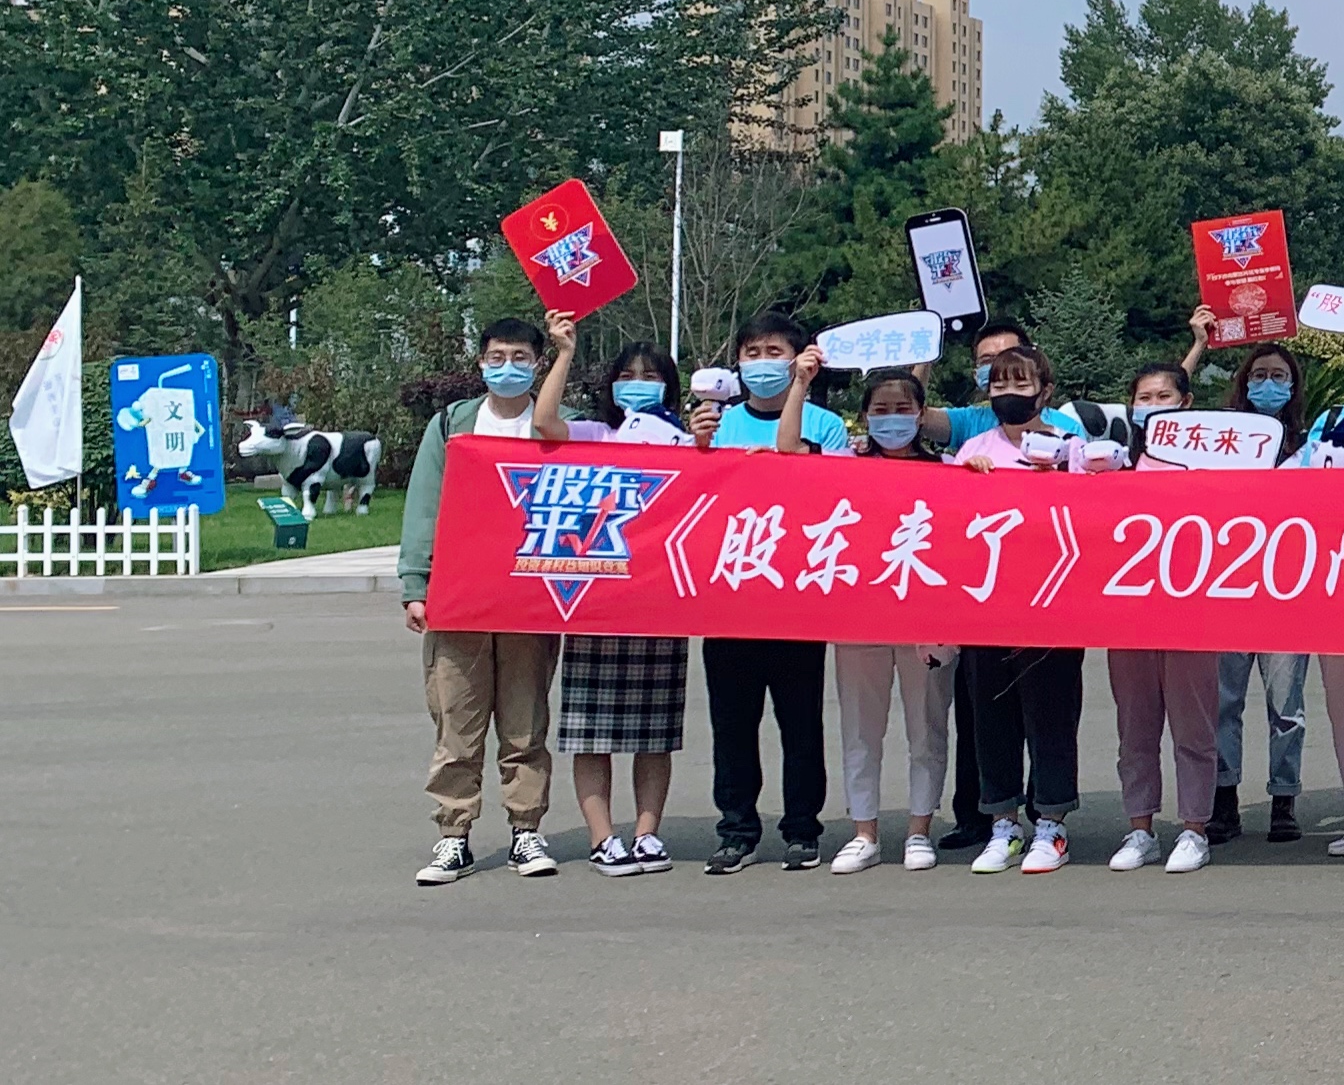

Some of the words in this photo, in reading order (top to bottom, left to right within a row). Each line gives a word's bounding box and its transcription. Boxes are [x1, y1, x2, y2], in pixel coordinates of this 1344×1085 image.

[825, 326, 934, 362] 知学竞赛
[163, 400, 185, 453] 文明
[1150, 419, 1273, 459] 股东来了
